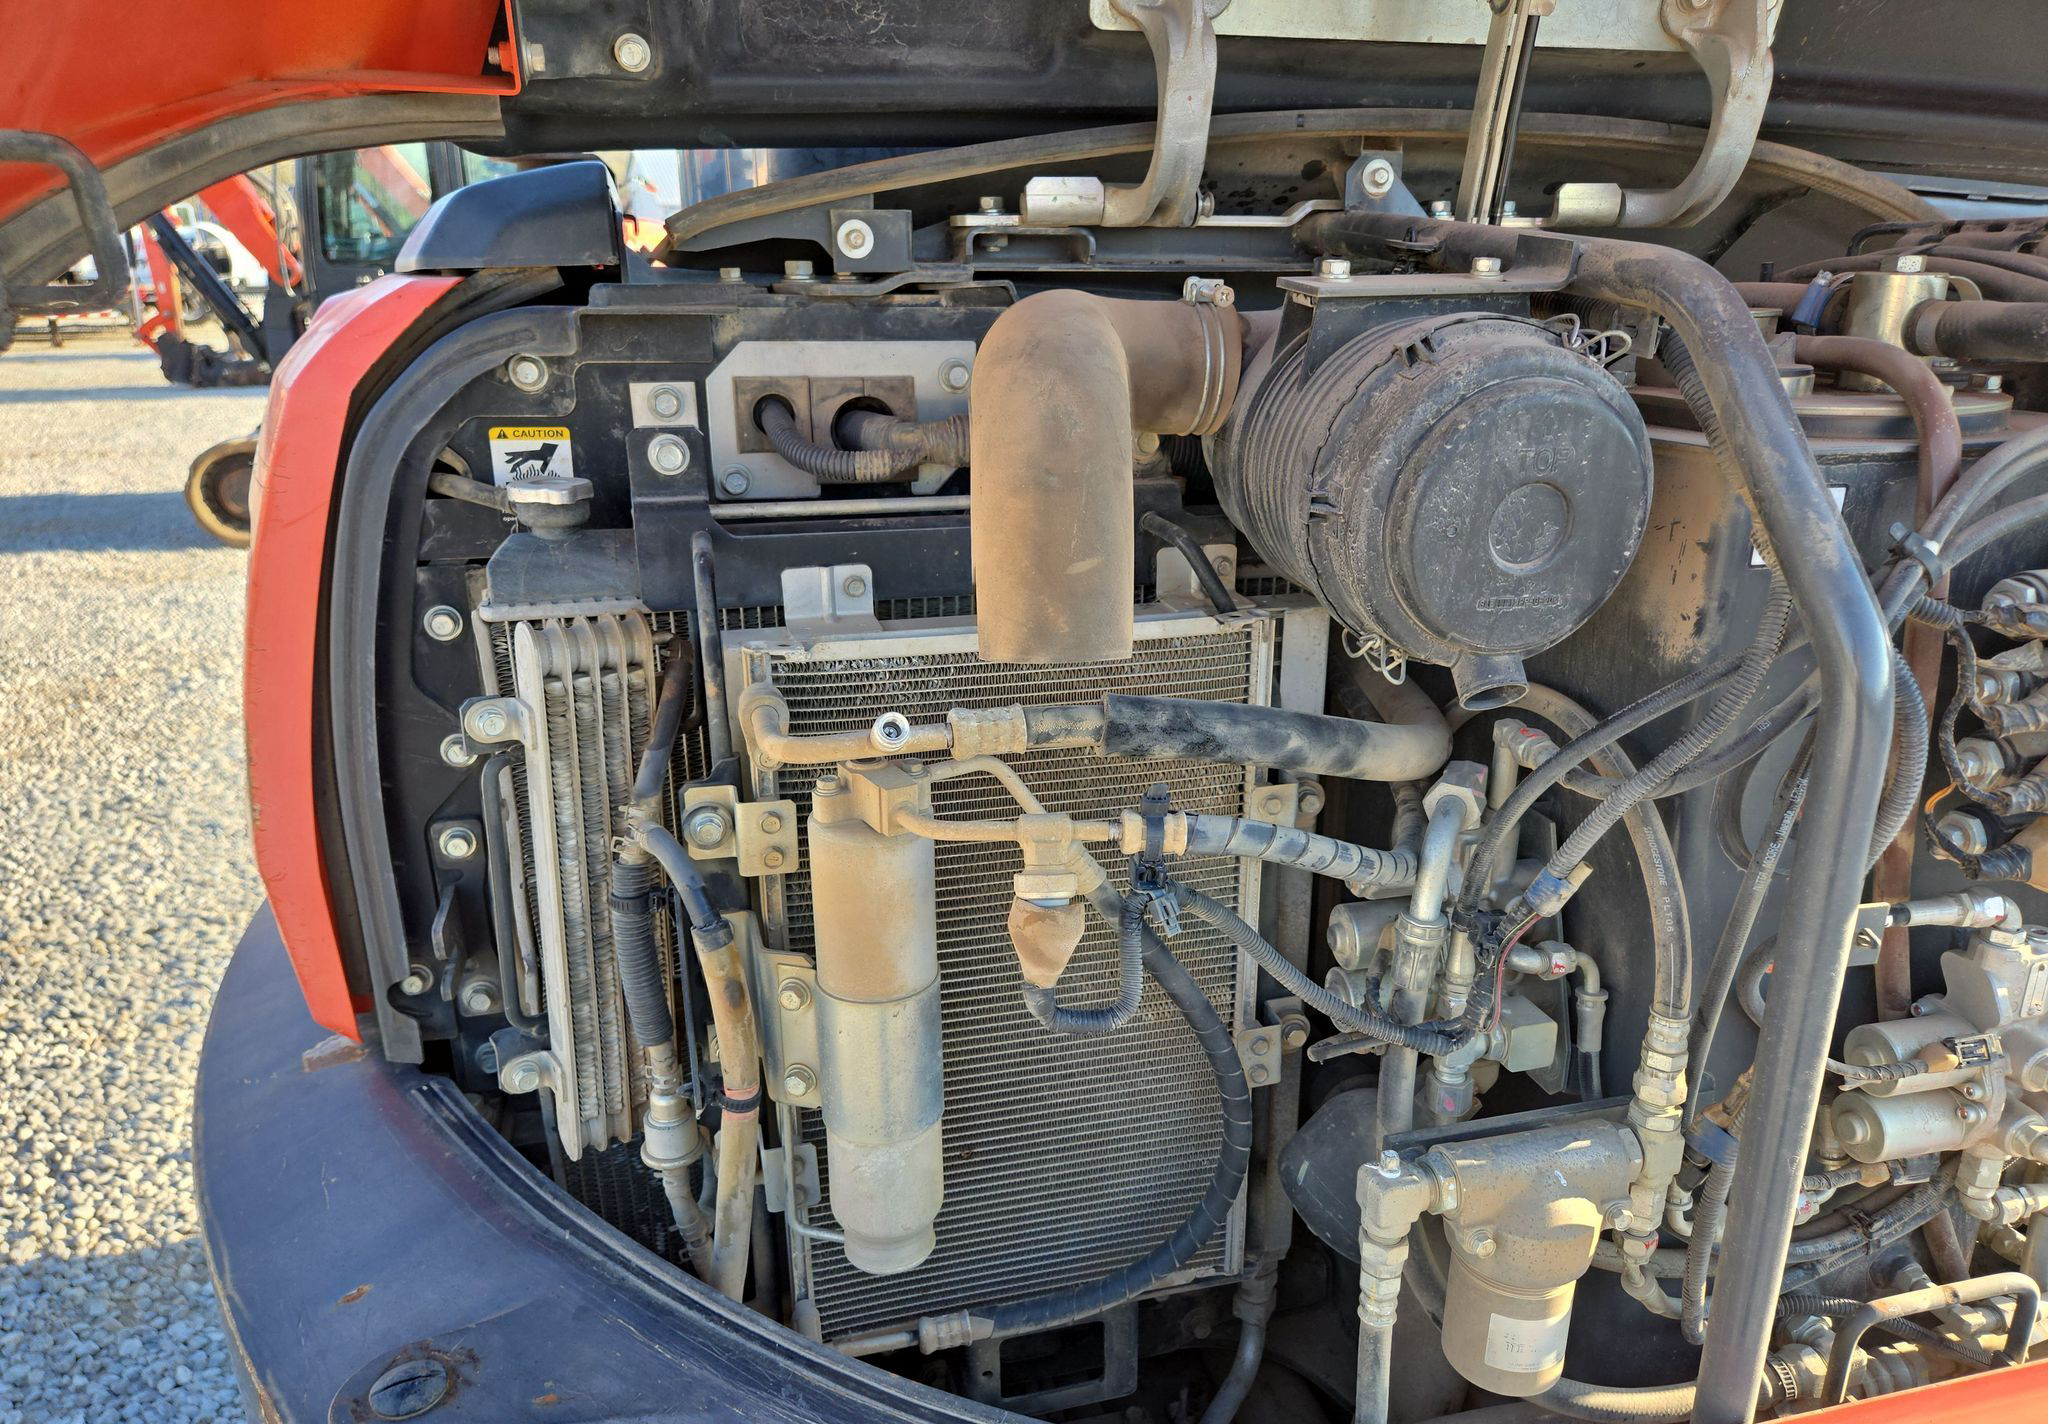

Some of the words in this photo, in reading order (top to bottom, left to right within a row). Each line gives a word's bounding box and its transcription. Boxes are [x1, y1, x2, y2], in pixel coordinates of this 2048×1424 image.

[512, 429, 564, 438] CAUTION
[1516, 447, 1575, 476] TOP
[1762, 842, 1780, 868] MOORE
[1643, 826, 1668, 887] BRIDGESTONE
[1663, 896, 1674, 933] PLT06
